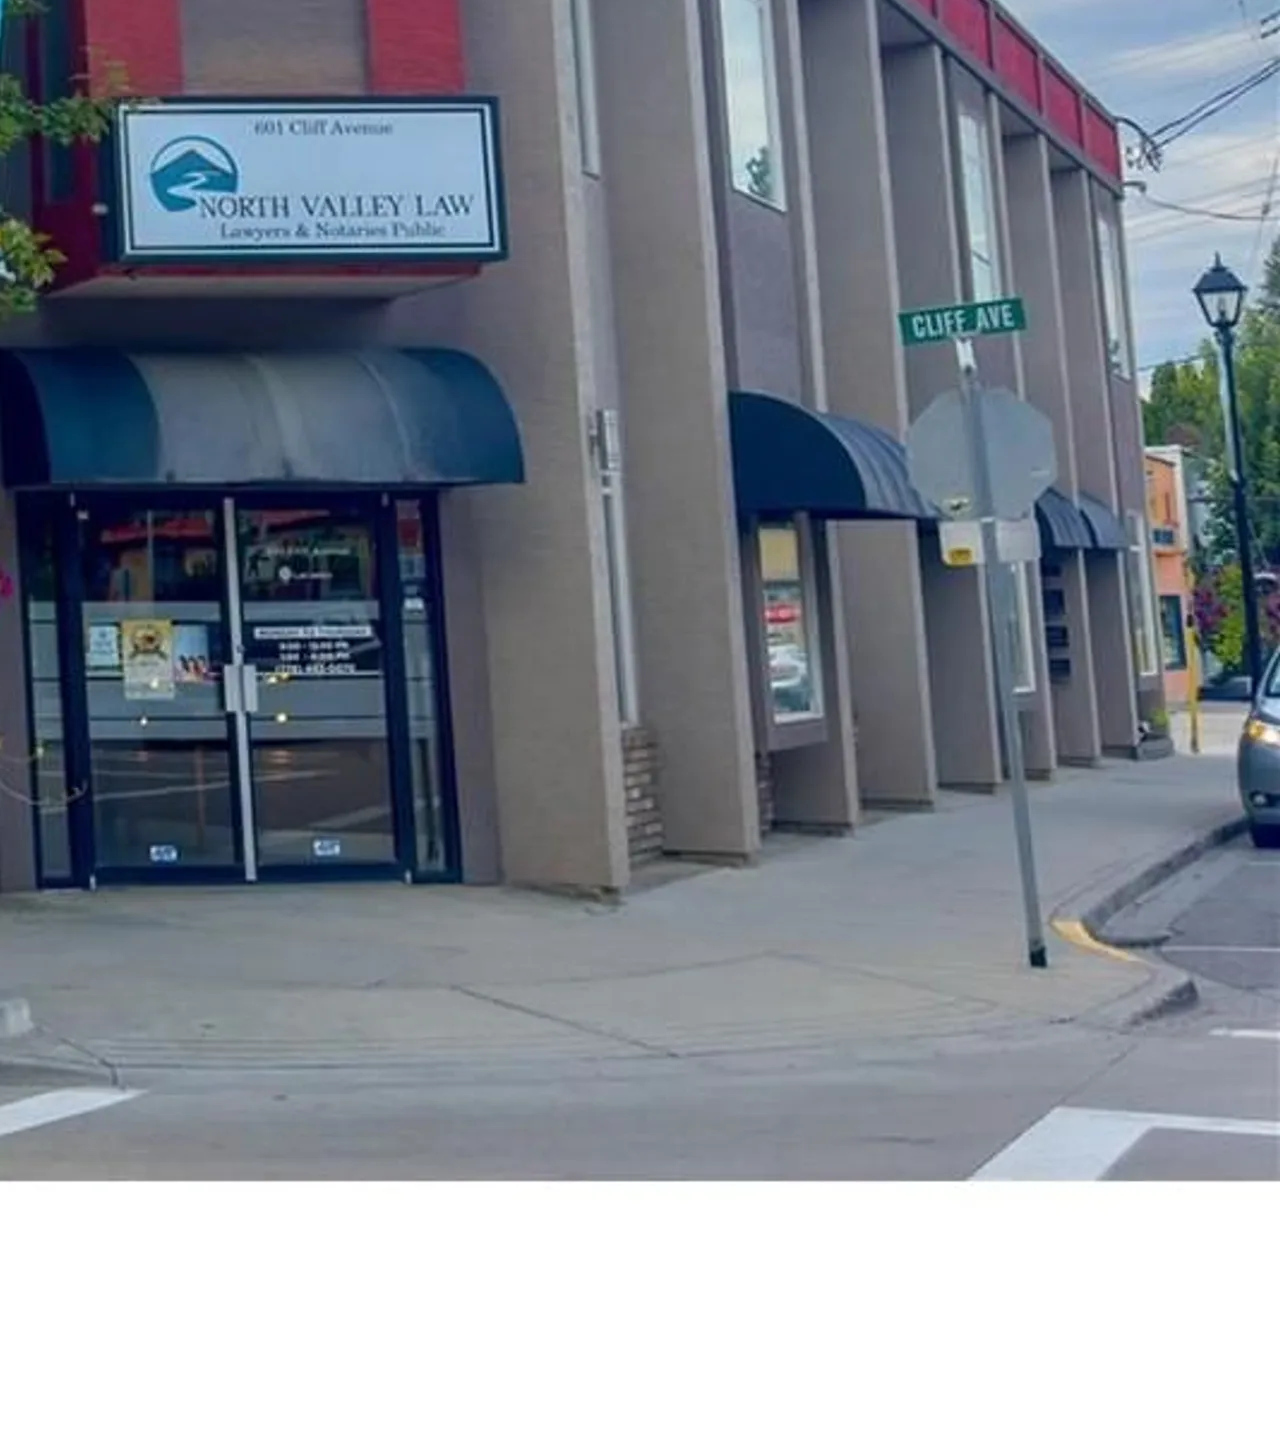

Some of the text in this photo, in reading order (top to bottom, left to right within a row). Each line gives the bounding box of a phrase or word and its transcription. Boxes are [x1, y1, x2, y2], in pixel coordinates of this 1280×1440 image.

[253, 118, 393, 136] 601 Cliff Avenue
[199, 192, 475, 218] NORTH VALLEY LAW
[220, 219, 446, 242] Lawyers & Notaries Public
[911, 303, 1016, 339] CLIFF AVE
